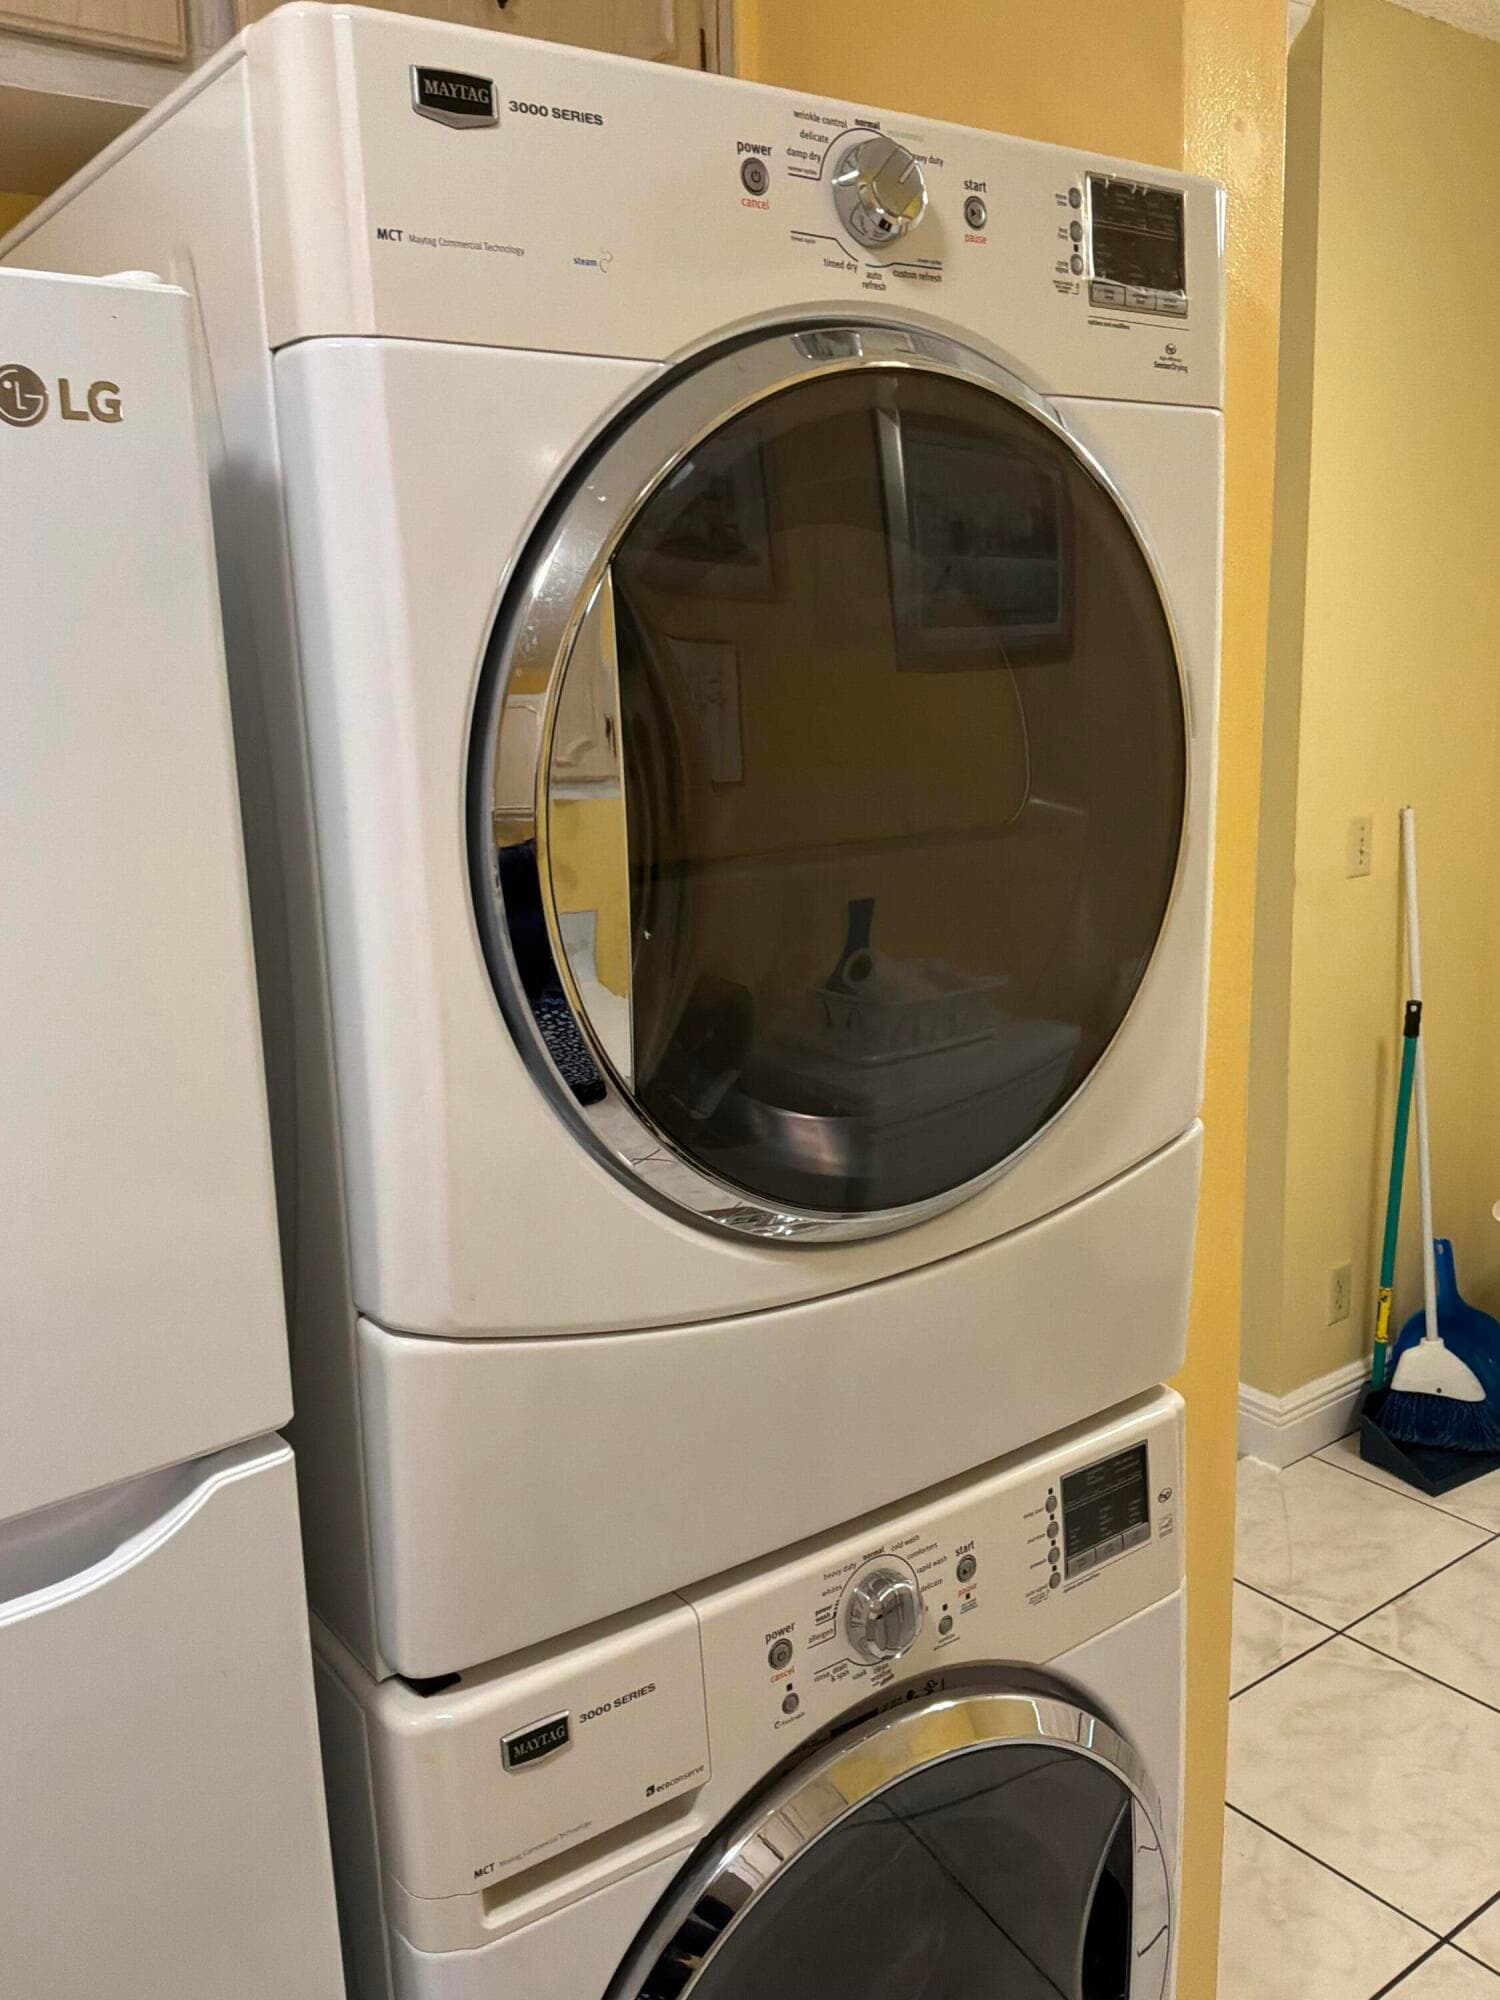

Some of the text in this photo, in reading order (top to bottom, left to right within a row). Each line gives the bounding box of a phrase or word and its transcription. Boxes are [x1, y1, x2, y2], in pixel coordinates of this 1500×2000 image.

[424, 78, 490, 105] MAYTAG
[508, 100, 604, 126] 3000 SERIES
[793, 109, 848, 130] wrinkle control
[854, 118, 881, 131] normal
[799, 129, 830, 144] delicate
[736, 141, 772, 157] power
[786, 147, 822, 164] damp dry
[963, 179, 987, 194] start
[741, 196, 770, 210] cancel
[377, 227, 404, 243] MCT
[964, 233, 987, 245] pause
[573, 256, 598, 268] steam
[823, 257, 858, 274] timed dry
[866, 271, 883, 281] auto
[892, 268, 943, 283] custom refresh
[861, 280, 887, 292] refresh
[58, 377, 124, 424] LG
[862, 1546, 885, 1561] normal
[955, 1540, 976, 1557] start
[957, 1582, 978, 1598] pause
[764, 1621, 796, 1645] power
[769, 1667, 796, 1684] cancel
[578, 1682, 657, 1724] 3000 SERIES
[512, 1724, 566, 1759] MAYTAG
[473, 1862, 496, 1880] MCT
